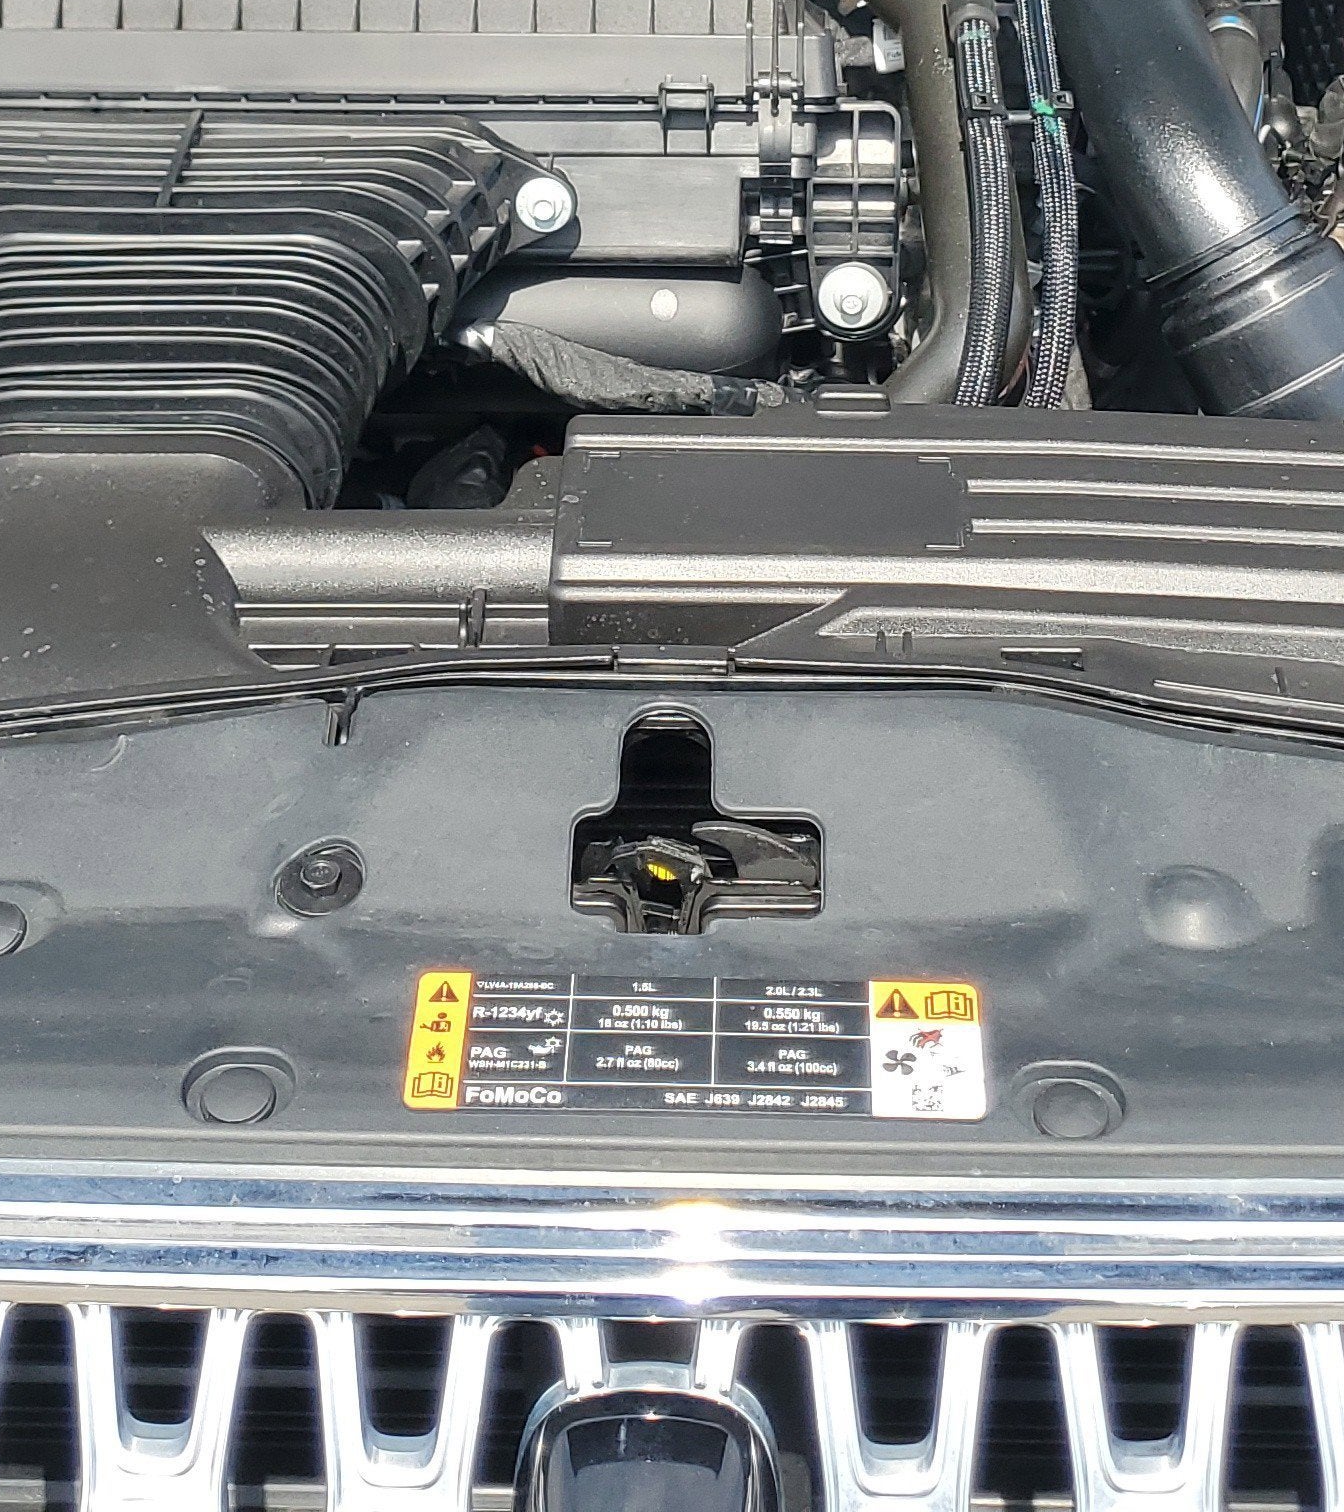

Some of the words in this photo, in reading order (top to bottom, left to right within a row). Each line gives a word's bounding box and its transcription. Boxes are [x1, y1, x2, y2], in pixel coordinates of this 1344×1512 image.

[765, 986, 790, 997] 2.0L
[797, 987, 823, 998] 2.3L
[472, 1006, 544, 1022] R-1234yf
[612, 1004, 649, 1018] 0.500
[651, 1004, 670, 1020] kg
[763, 1007, 801, 1020] 0.550
[803, 1008, 821, 1023] kg
[614, 1020, 629, 1029] oz
[630, 1018, 659, 1031] (1.10
[660, 1018, 683, 1031] lbs)
[771, 1023, 787, 1032] oz
[788, 1021, 815, 1034] (1.21
[818, 1022, 840, 1035] lbs)
[470, 1046, 508, 1059] PAG
[625, 1044, 654, 1056] PAG
[778, 1049, 807, 1060] PAG
[596, 1056, 615, 1068] 2.7
[616, 1056, 625, 1068] fl
[626, 1058, 642, 1068] oz
[746, 1060, 766, 1073] 3.4
[767, 1061, 776, 1073] fl
[777, 1063, 793, 1073] oz
[794, 1061, 838, 1076] (100cc)
[465, 1086, 562, 1104] FoMoCo
[664, 1092, 698, 1105] SAE
[704, 1092, 740, 1106] J639
[747, 1094, 791, 1107] J2842
[800, 1095, 845, 1108] J2845
